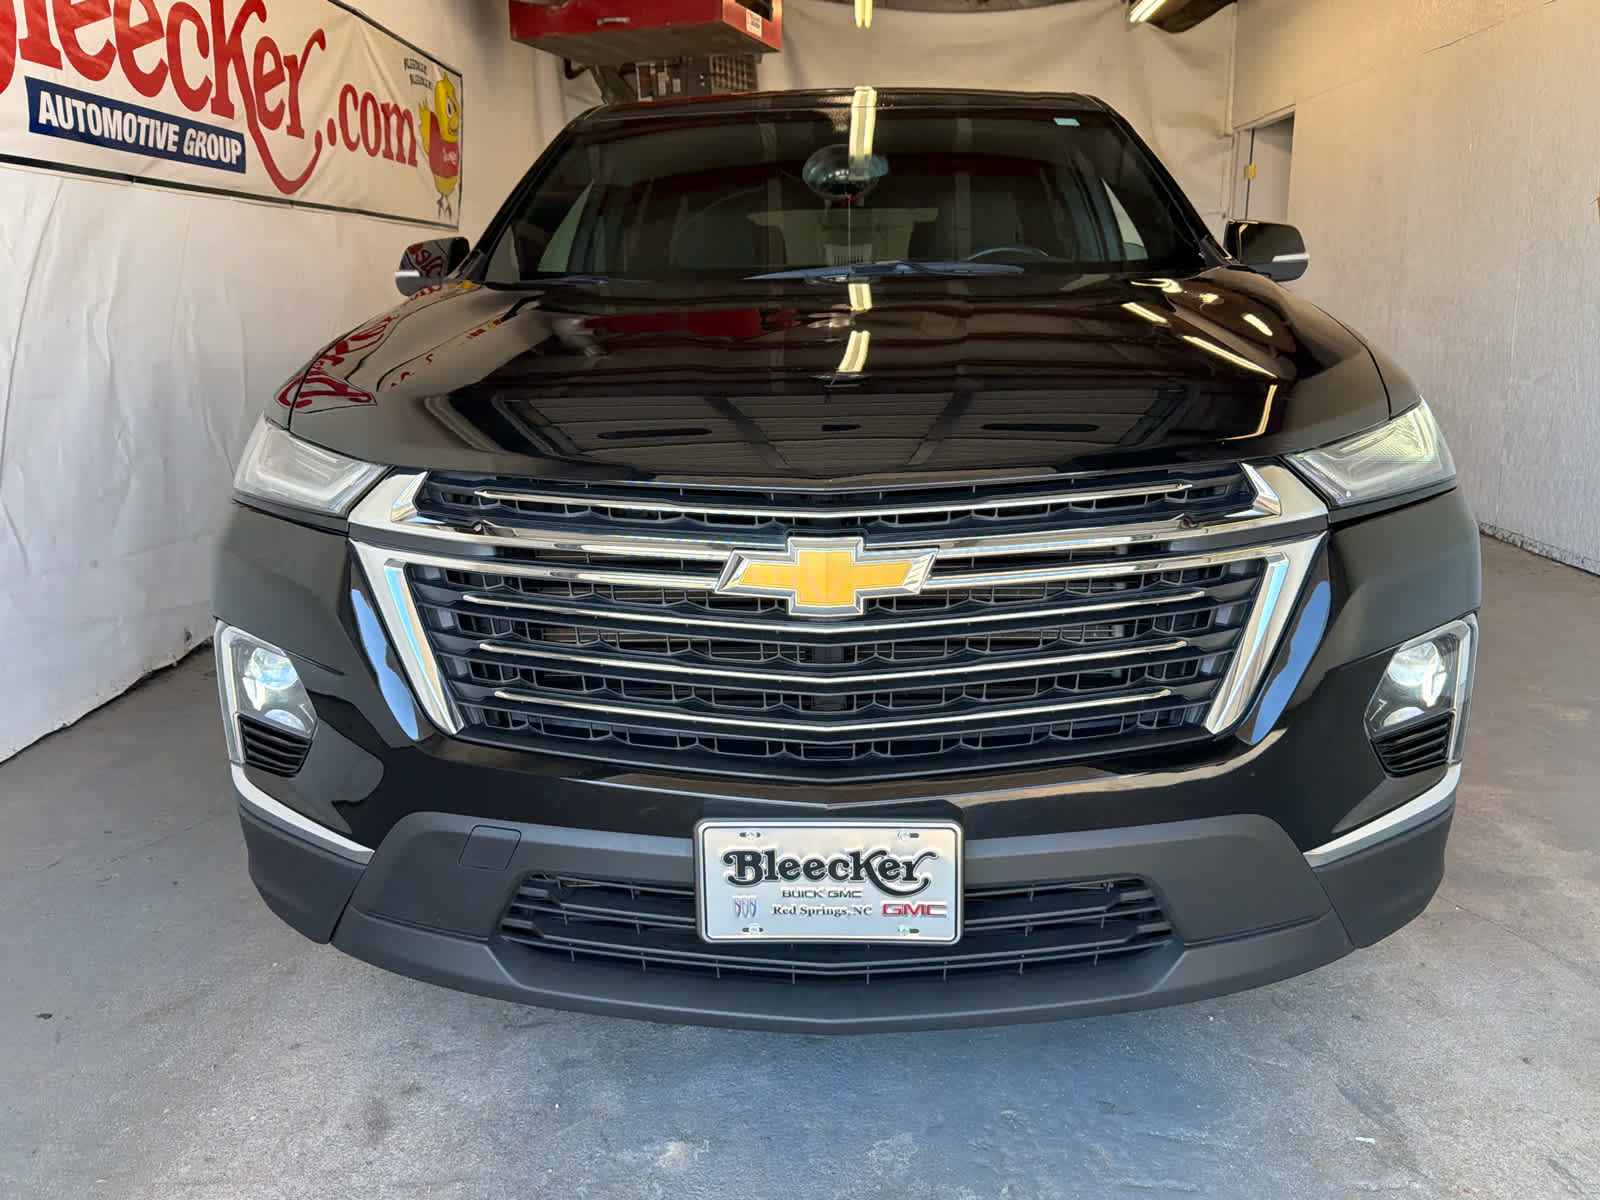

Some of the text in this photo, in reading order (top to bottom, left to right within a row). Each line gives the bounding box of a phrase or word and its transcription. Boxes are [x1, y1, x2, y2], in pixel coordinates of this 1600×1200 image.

[38, 90, 242, 165] AUTOMOTIVE GROUP
[782, 889, 864, 899] BUICK GMC
[773, 905, 797, 915] Red
[854, 906, 873, 915] NC
[882, 903, 947, 918] GMC
